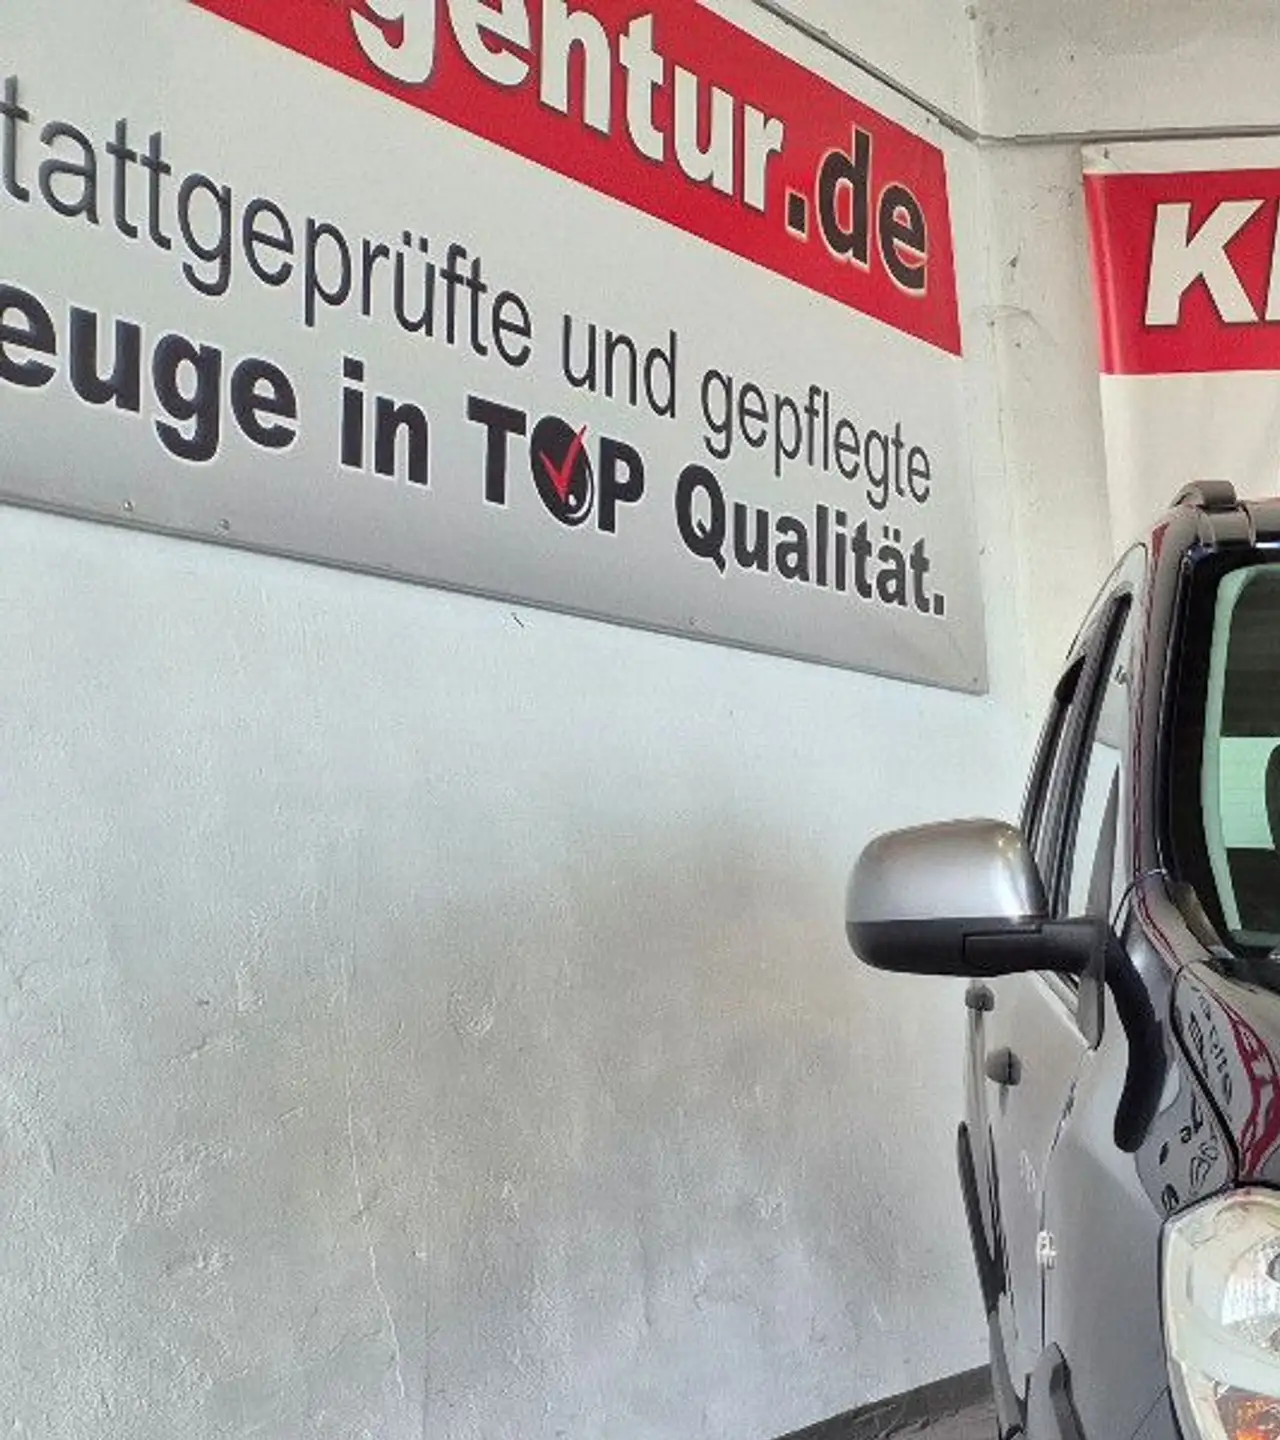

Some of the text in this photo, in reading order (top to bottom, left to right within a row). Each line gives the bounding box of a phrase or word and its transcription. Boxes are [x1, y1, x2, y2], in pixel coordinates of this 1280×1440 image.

[339, 361, 429, 487] in
[466, 394, 646, 534] TOP
[674, 464, 946, 616] Qualität.
[563, 314, 678, 420] und
[701, 367, 933, 511] gepflegte
